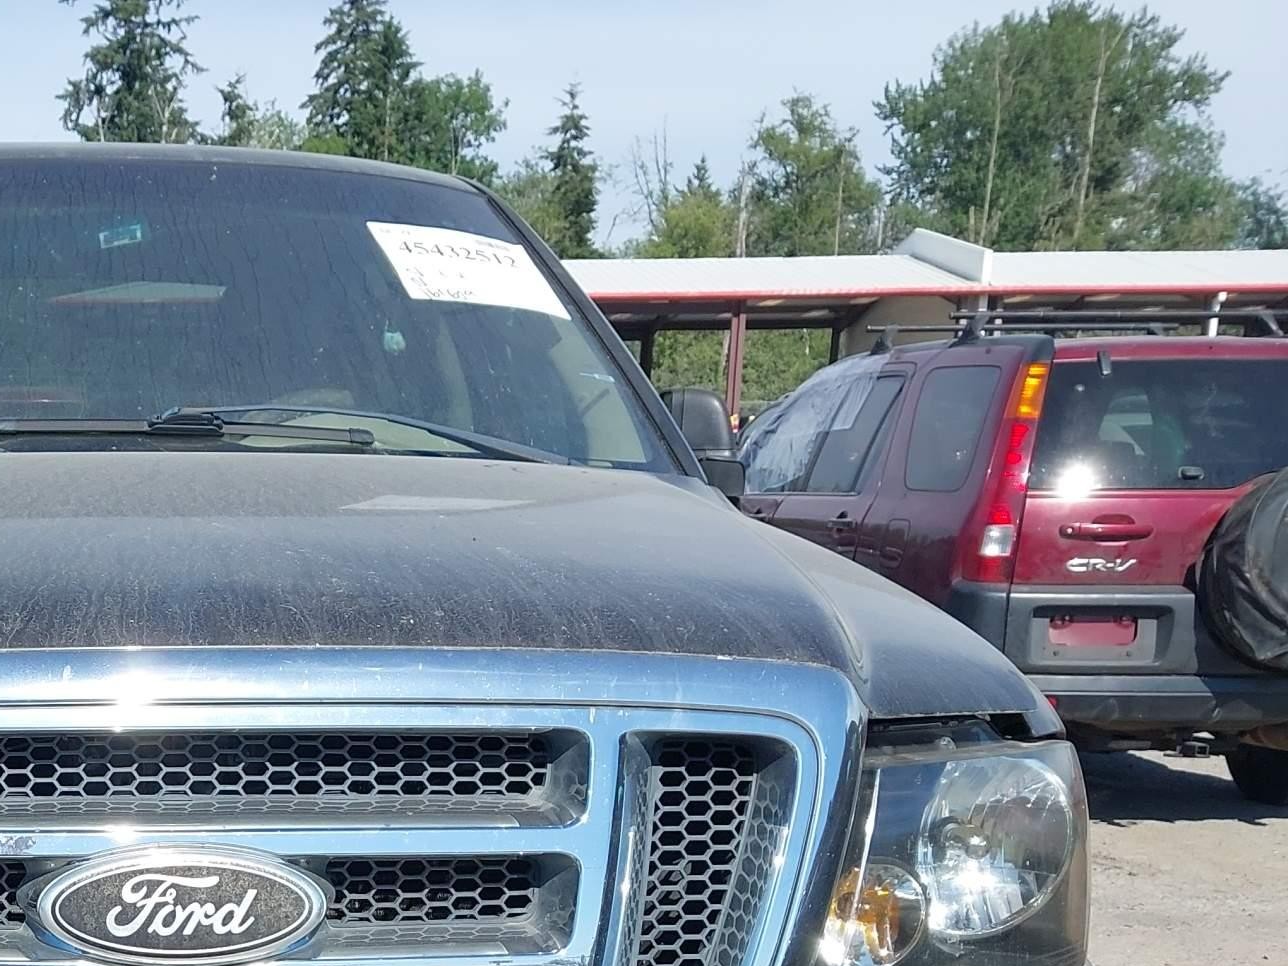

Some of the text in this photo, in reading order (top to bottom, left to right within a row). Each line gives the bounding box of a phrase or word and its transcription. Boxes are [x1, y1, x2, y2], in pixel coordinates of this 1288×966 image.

[399, 240, 519, 268] 45432512
[1066, 557, 1137, 573] CR-V
[106, 873, 258, 938] Ford
